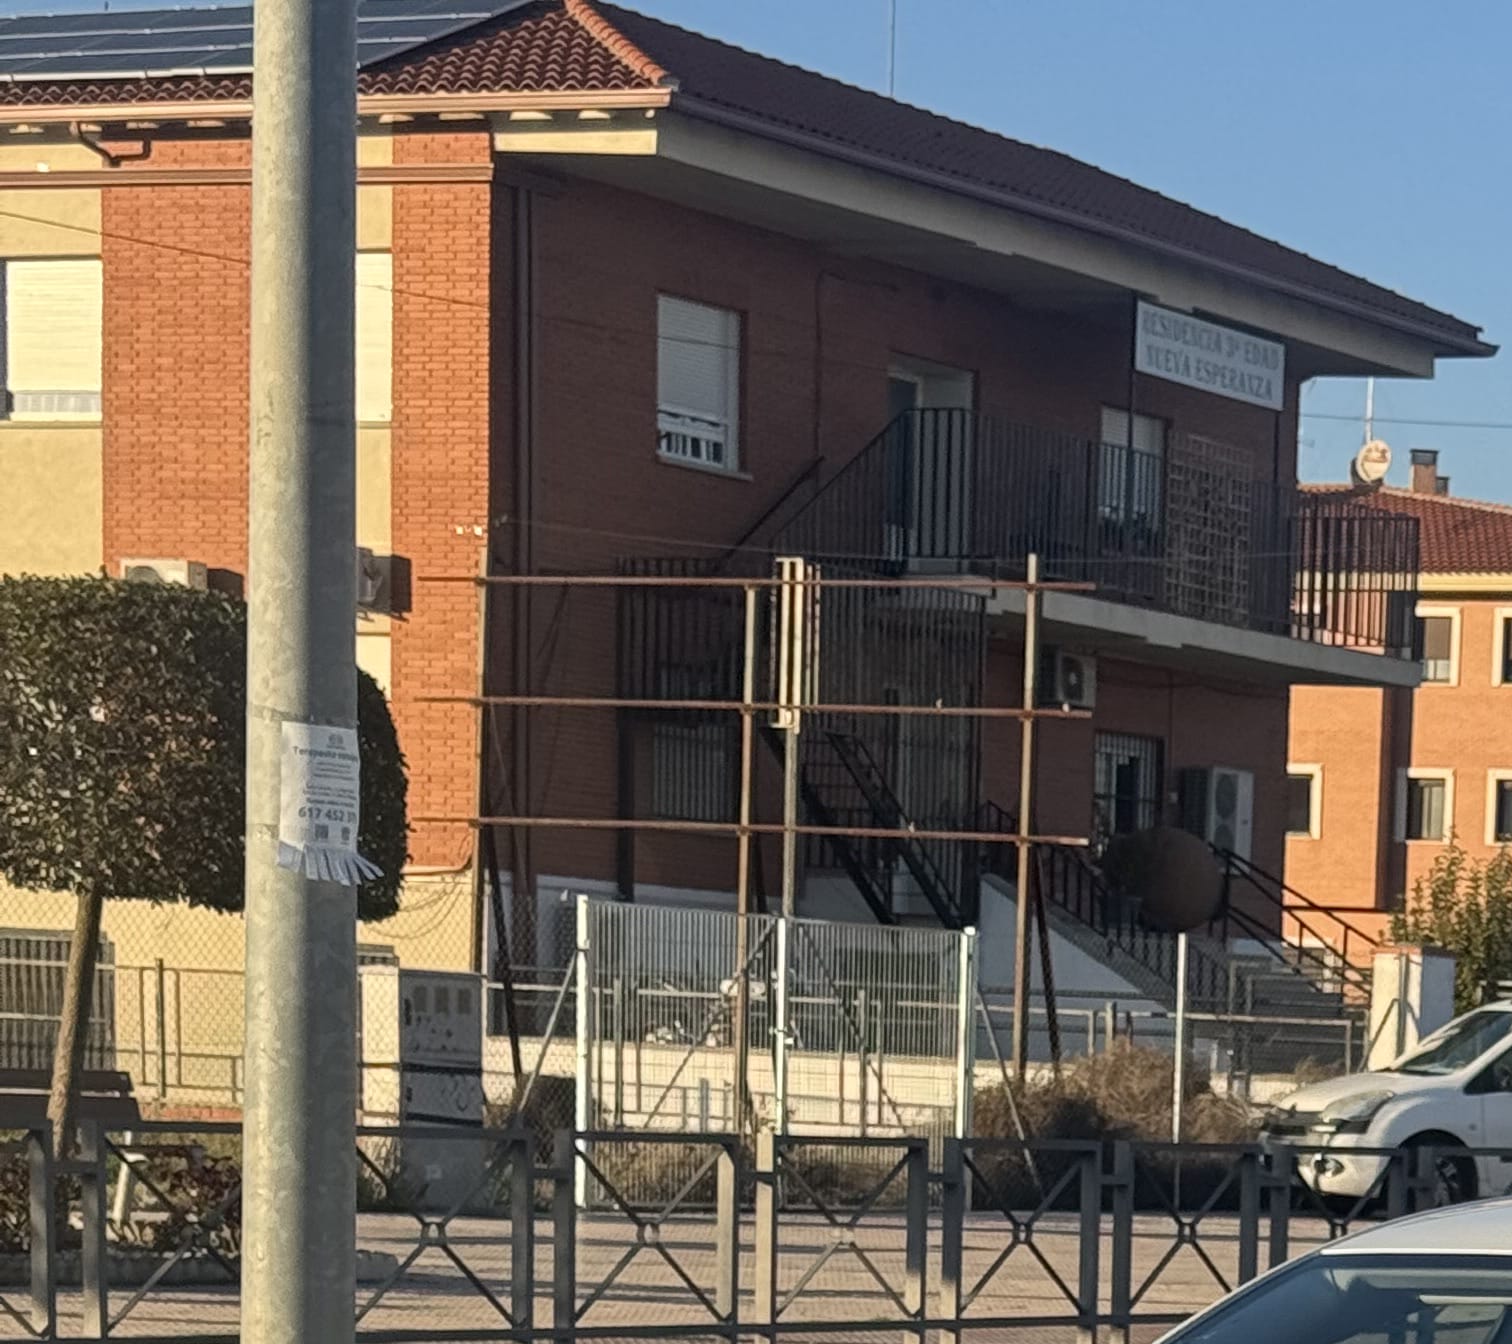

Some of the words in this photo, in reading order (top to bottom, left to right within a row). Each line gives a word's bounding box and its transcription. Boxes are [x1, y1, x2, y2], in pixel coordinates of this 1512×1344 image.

[1142, 311, 1223, 353] RESIDENCIA
[1244, 341, 1280, 371] EDAD
[1145, 345, 1191, 378] NUEVA
[1195, 358, 1273, 401] ESPERANZA
[298, 806, 321, 820] 617
